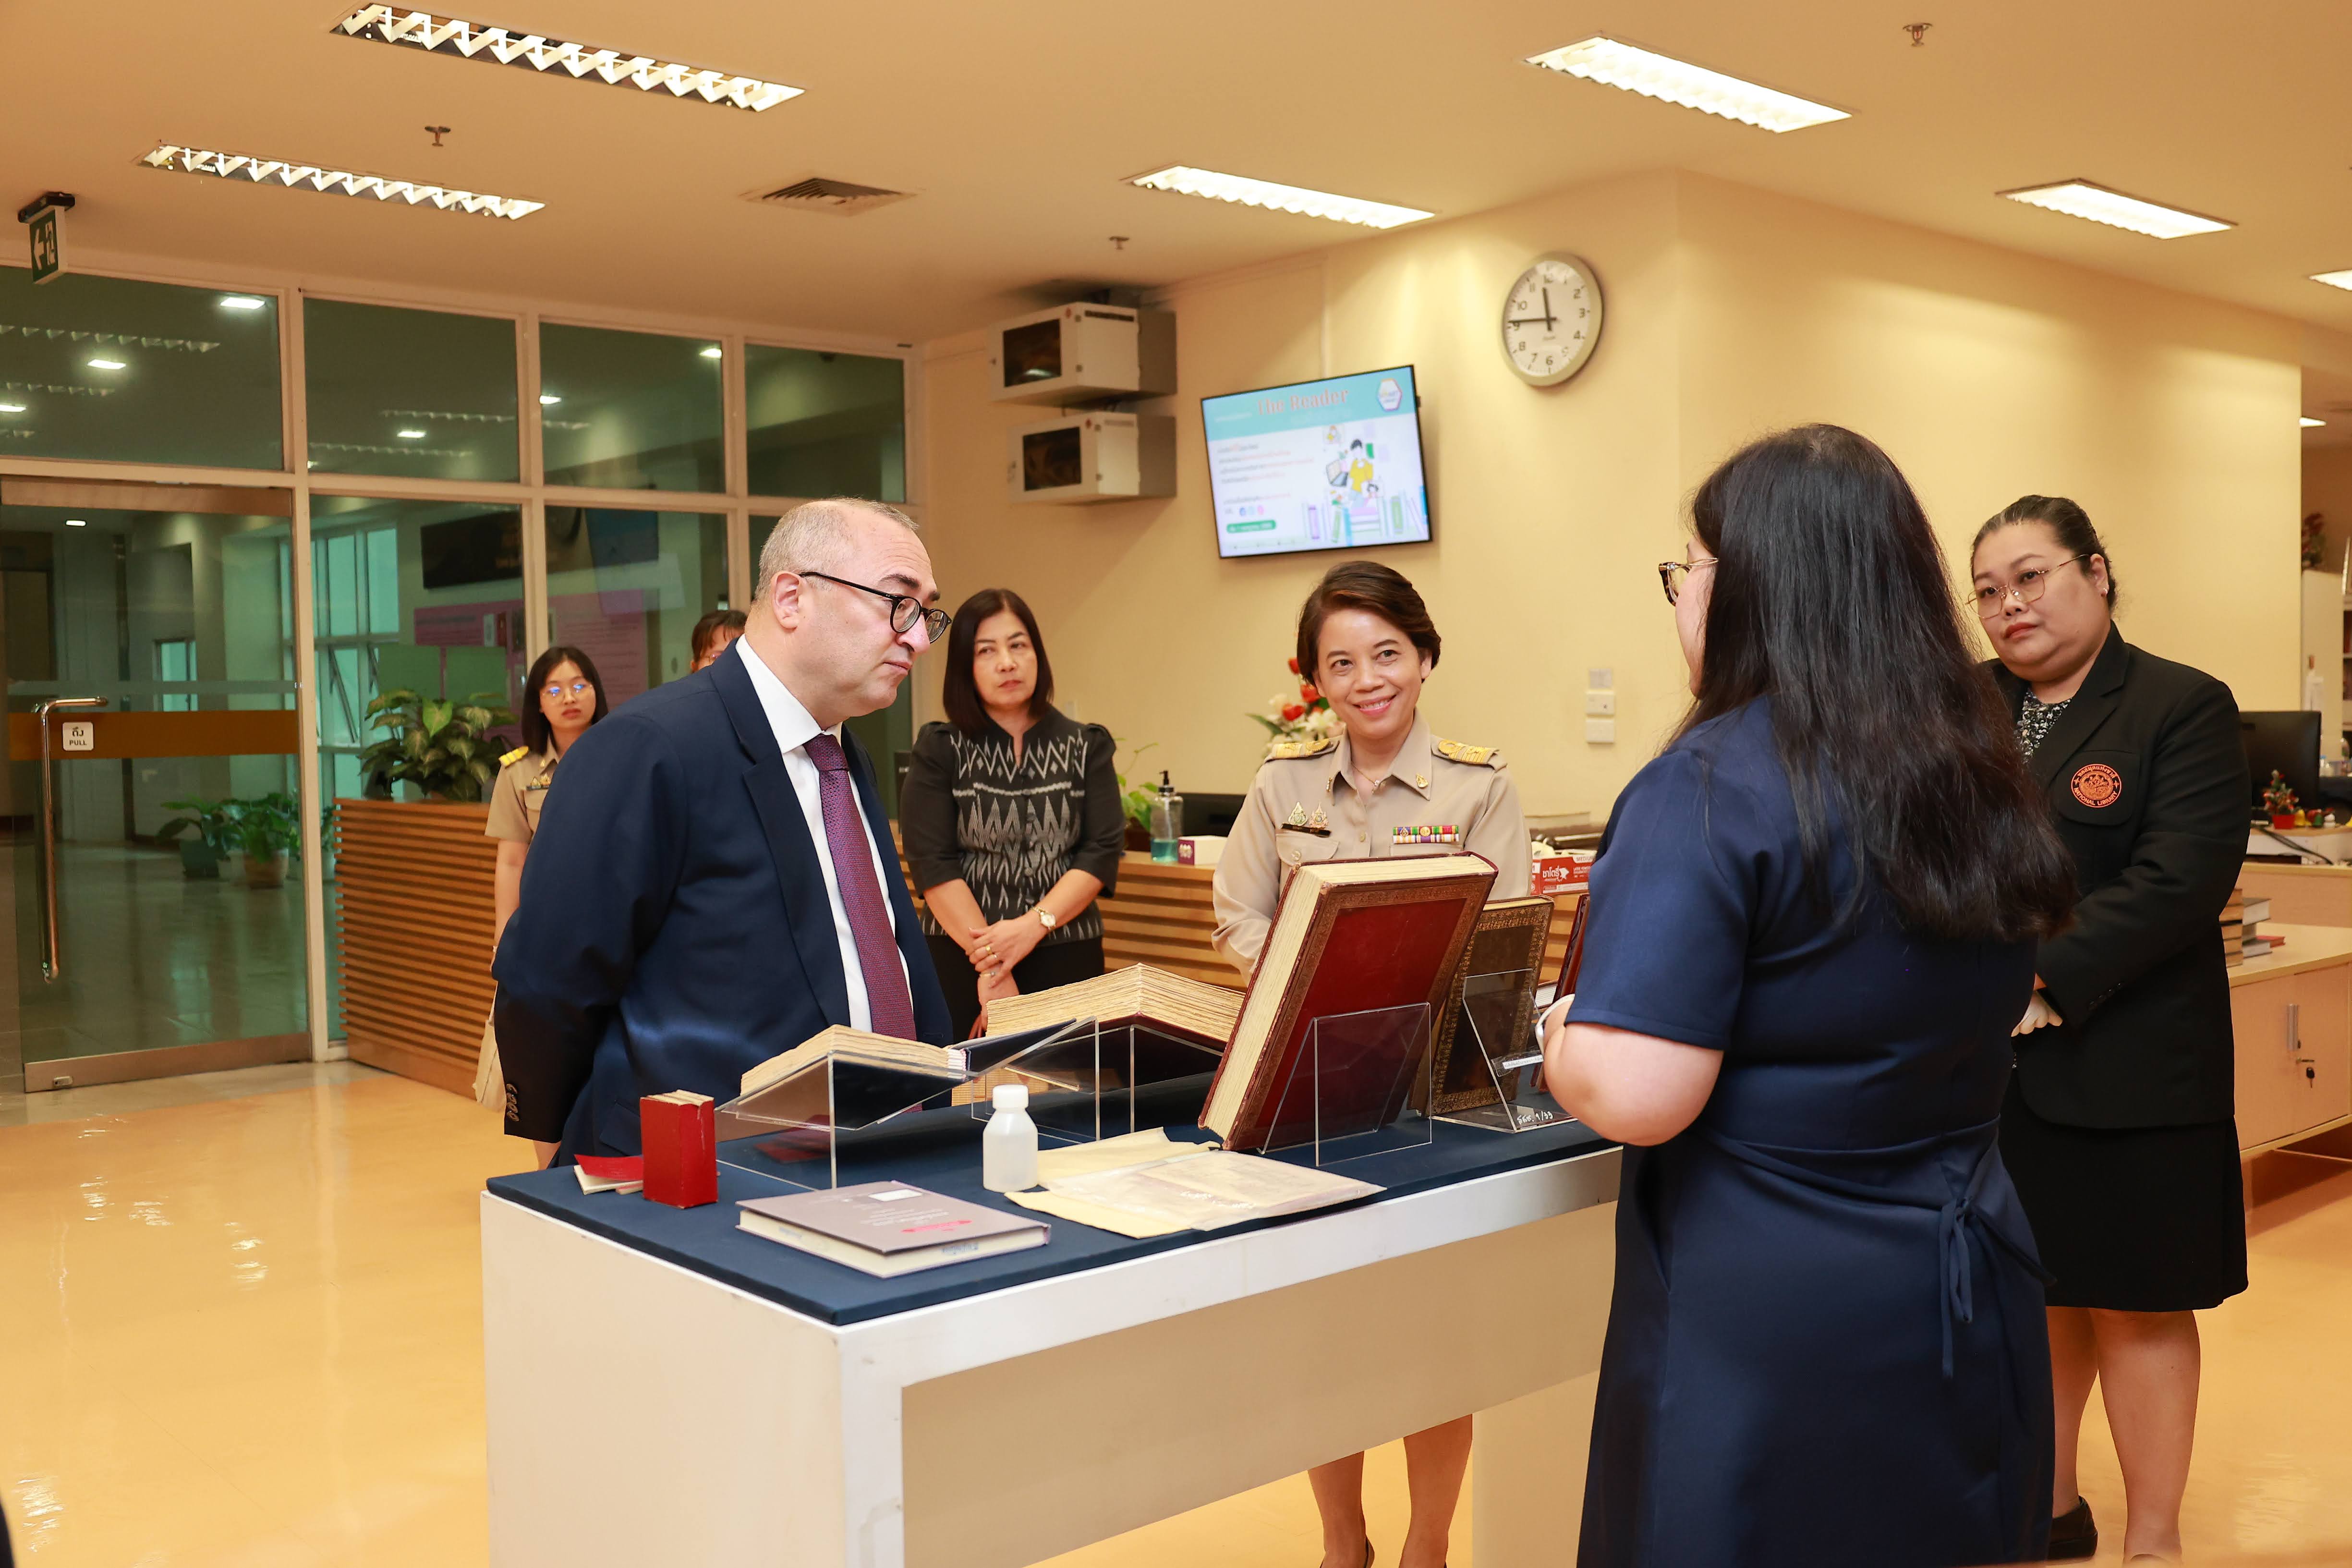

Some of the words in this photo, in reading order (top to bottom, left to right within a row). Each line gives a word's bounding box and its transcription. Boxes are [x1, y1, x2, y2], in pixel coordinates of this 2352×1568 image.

[1573, 289, 1580, 299] 2
[1517, 301, 1527, 310] 10
[1579, 308, 1585, 318] 3
[1573, 330, 1580, 340] 4
[1519, 341, 1526, 351] 8
[1531, 352, 1538, 363] 7
[1546, 355, 1553, 365] 6
[1258, 398, 1285, 415] The
[1289, 389, 1348, 409] Reader
[2073, 787, 2096, 806] NATIONAL
[2097, 790, 2118, 806] LIBRARY
